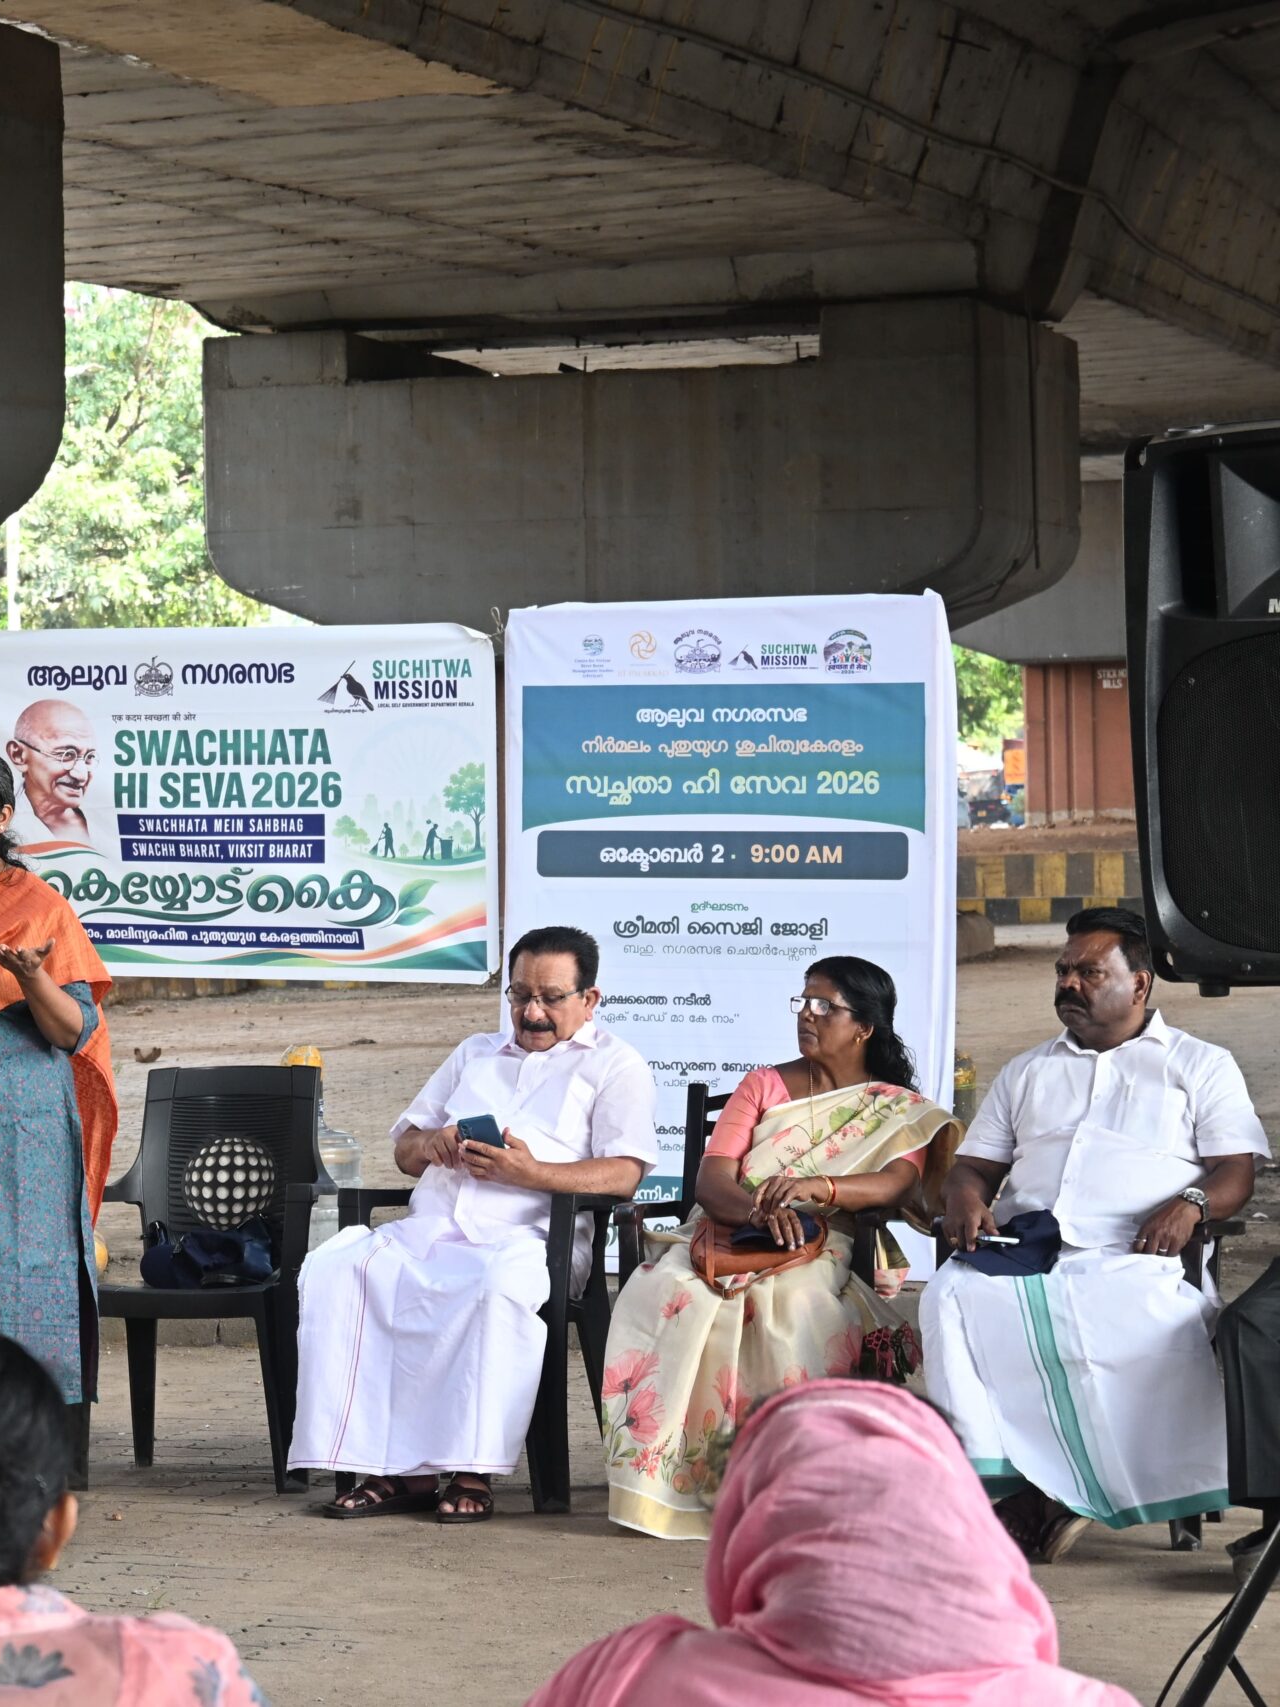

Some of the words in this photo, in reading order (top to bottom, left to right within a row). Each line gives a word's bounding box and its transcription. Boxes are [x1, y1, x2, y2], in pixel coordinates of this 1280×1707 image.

[761, 644, 818, 655] SUCHITWA
[372, 658, 472, 679] SUCHITWA
[761, 655, 807, 666] MISSION
[27, 664, 127, 691] ആലുവ
[181, 662, 295, 684] നഗരസഭ
[374, 680, 458, 700] MISSION
[111, 714, 124, 722] एक
[125, 714, 142, 722] कदम
[144, 714, 170, 722] स्वच्छता
[172, 712, 181, 721] की
[183, 712, 196, 721] ओर
[636, 707, 704, 728] ആലുവ
[712, 707, 808, 723] നഗരസഭ
[114, 728, 332, 767] SWACHHATA
[658, 739, 728, 758] പുതുയുഗ
[735, 735, 864, 758] ശുചിത്വകേരളം
[114, 772, 148, 808] HI
[159, 772, 247, 809] SEVA
[251, 771, 342, 808] 2026
[565, 774, 672, 805] സ്വച്ഛതാ
[682, 768, 720, 795] ഹി
[730, 775, 807, 795] സേവ
[816, 771, 880, 795] 2026
[138, 818, 208, 833] SWACHHATA
[213, 818, 243, 833] MEIN
[249, 818, 304, 833] SAHBHAG
[132, 842, 175, 858] SWACHH
[180, 843, 224, 860] BHARAT,
[228, 843, 265, 858] VIKSIT
[269, 843, 313, 858] BHARAT
[599, 843, 704, 872] ഒക്ടോബർ
[711, 844, 725, 864] 2
[750, 844, 800, 864] 9:00
[805, 845, 843, 864] AM
[106, 927, 189, 944] മാലിന്യരഹിത
[191, 930, 257, 945] പുതുയുഗ
[259, 930, 360, 946] കേരളത്തിനായി
[613, 915, 680, 938] ശ്രീമതി
[687, 917, 763, 936] സൈജി
[770, 918, 828, 941] ജോളി
[623, 944, 657, 957] ബഹു.
[662, 944, 721, 956] നഗരസഭ
[672, 992, 712, 1006] നടീൽ
[670, 1013, 685, 1023] മാ
[688, 1014, 707, 1024] കേ
